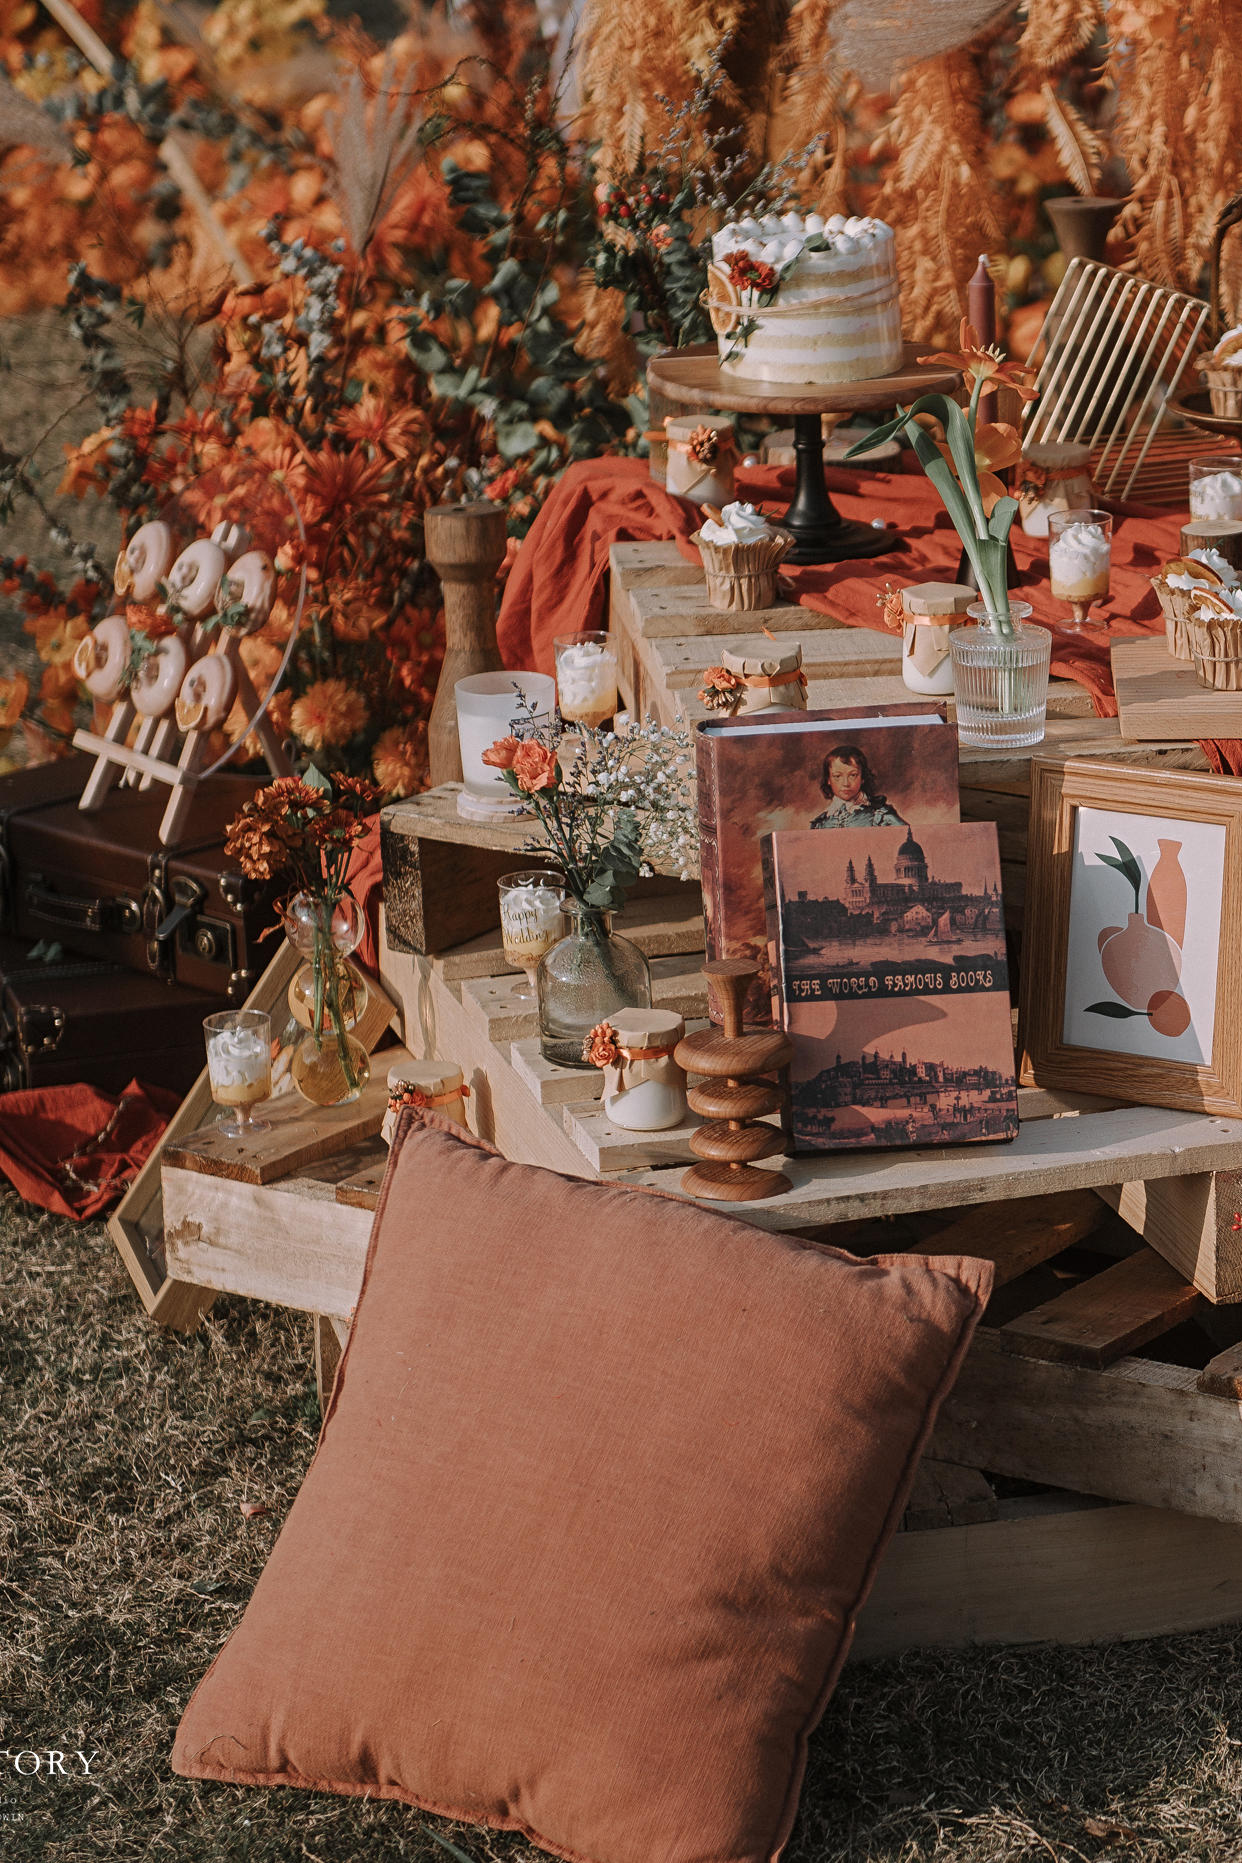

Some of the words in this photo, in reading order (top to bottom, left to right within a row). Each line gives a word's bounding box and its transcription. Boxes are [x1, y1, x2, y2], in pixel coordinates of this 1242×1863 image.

[792, 979, 821, 997] THE
[827, 976, 878, 995] WORLD
[884, 972, 943, 991] FAMOUS
[949, 969, 994, 988] BOOKS
